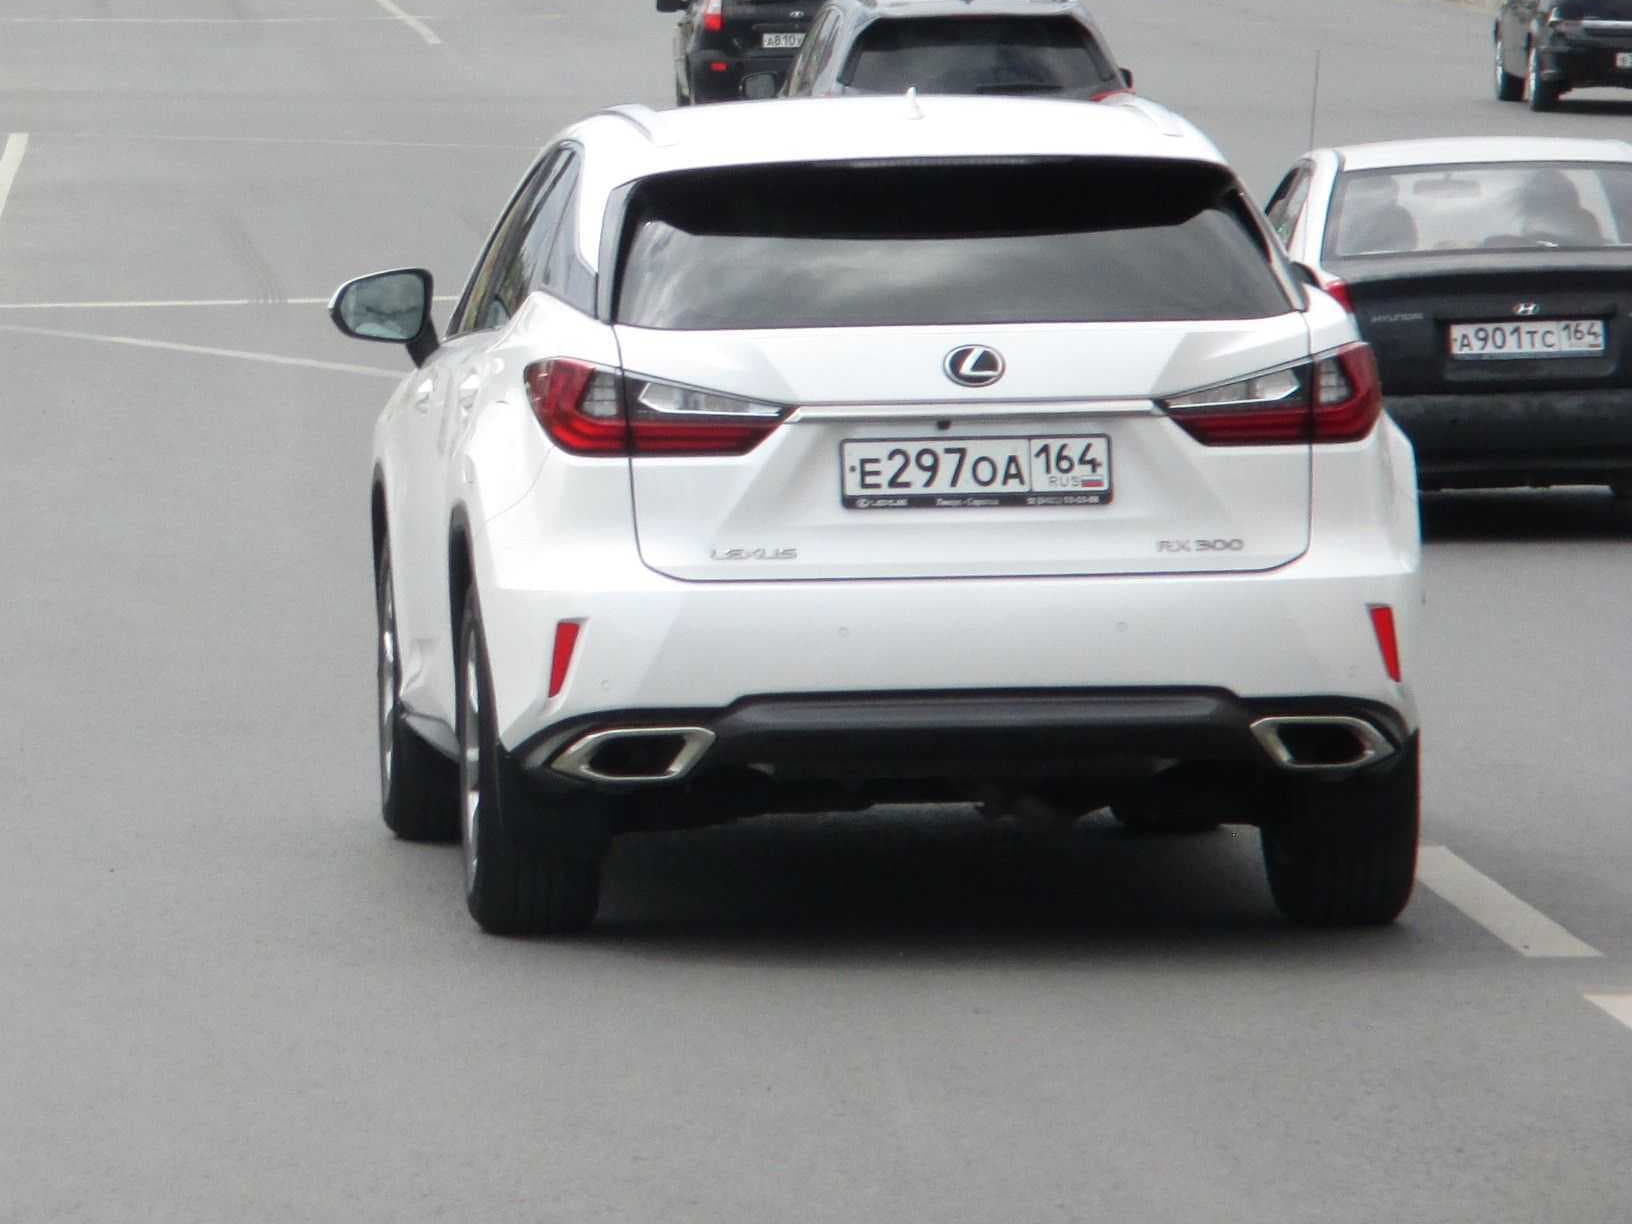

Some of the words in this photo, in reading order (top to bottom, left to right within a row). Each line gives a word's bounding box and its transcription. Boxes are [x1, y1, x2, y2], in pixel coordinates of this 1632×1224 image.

[1458, 325, 1556, 352] А901ТС
[1562, 322, 1601, 341] 164
[857, 446, 1026, 490] Е297ОА
[1033, 441, 1103, 475] 164
[1047, 475, 1081, 489] RUS
[1194, 538, 1245, 553] 300
